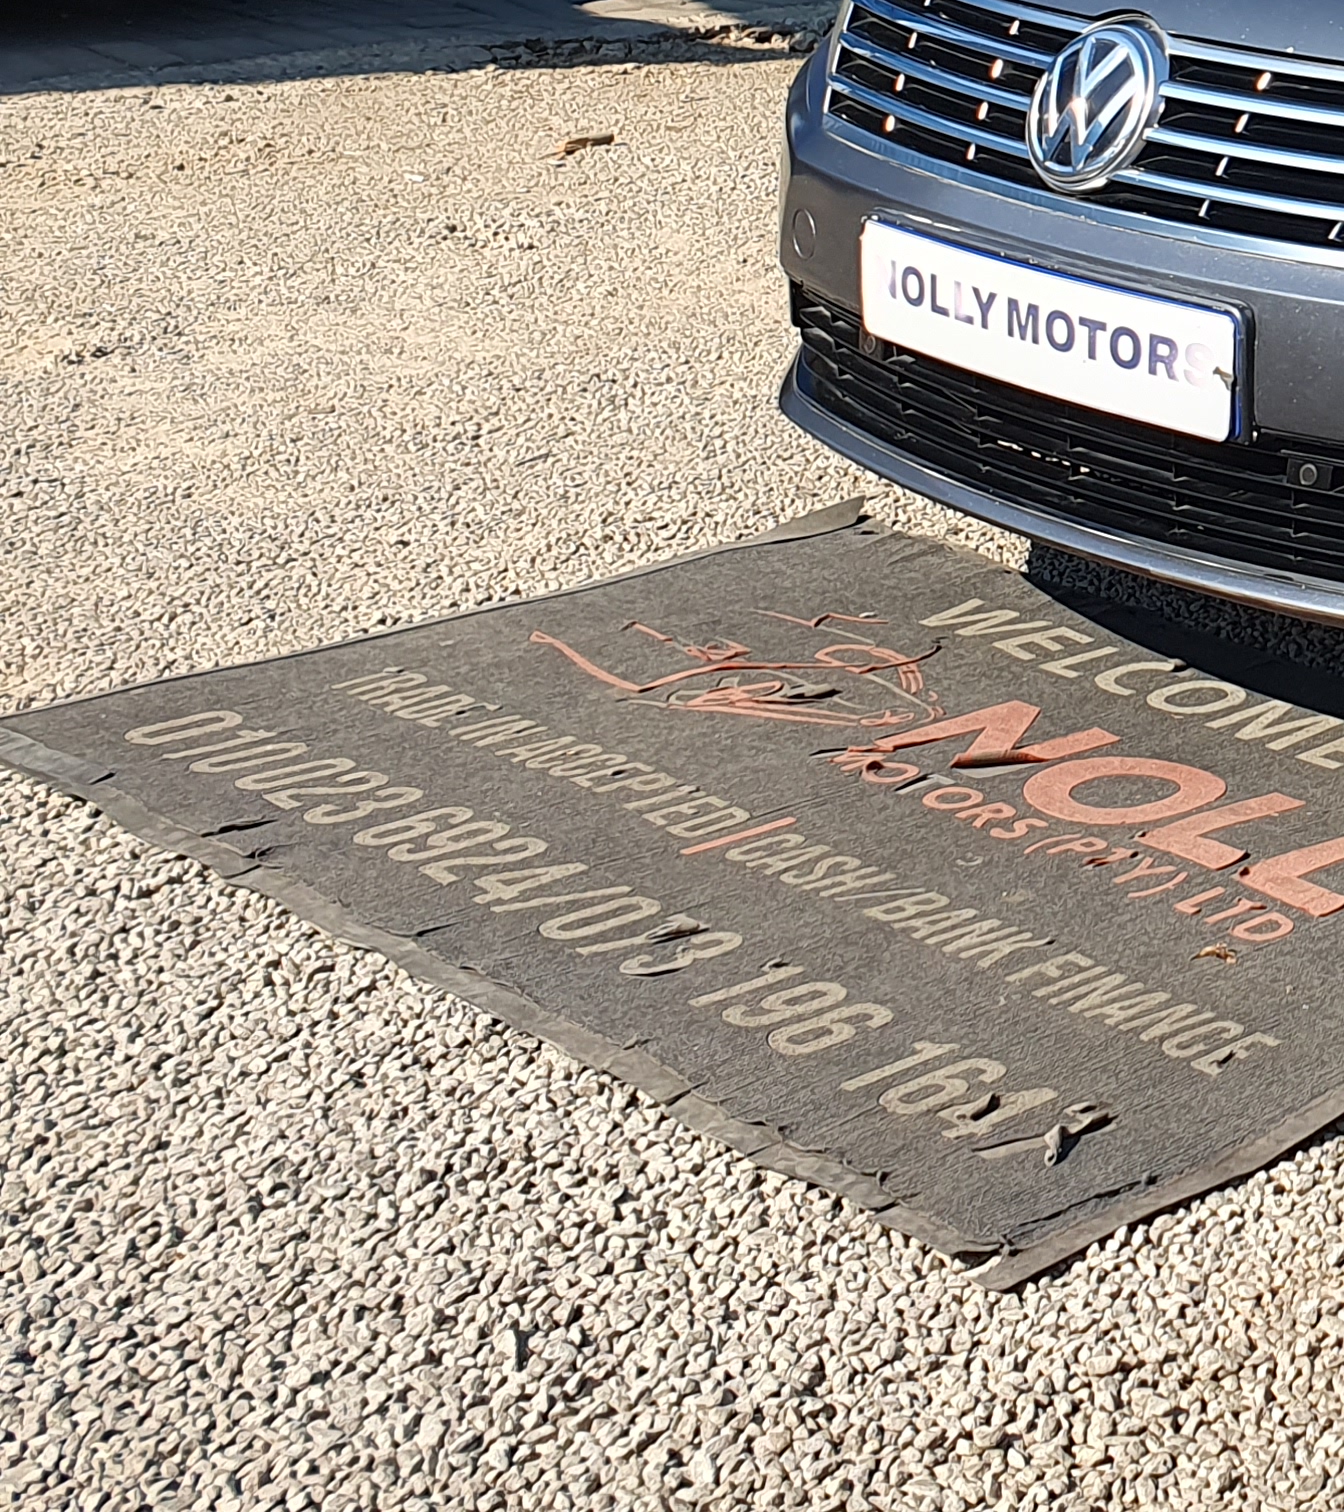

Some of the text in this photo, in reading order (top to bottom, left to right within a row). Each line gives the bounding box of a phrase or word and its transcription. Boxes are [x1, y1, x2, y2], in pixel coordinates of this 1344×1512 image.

[1006, 296, 1217, 388] MOTORS
[332, 666, 503, 728] TRADE
[448, 714, 550, 748] IN
[1005, 951, 1283, 1078] FINANCE
[1173, 886, 1295, 942] LTD
[688, 957, 894, 1057] 196
